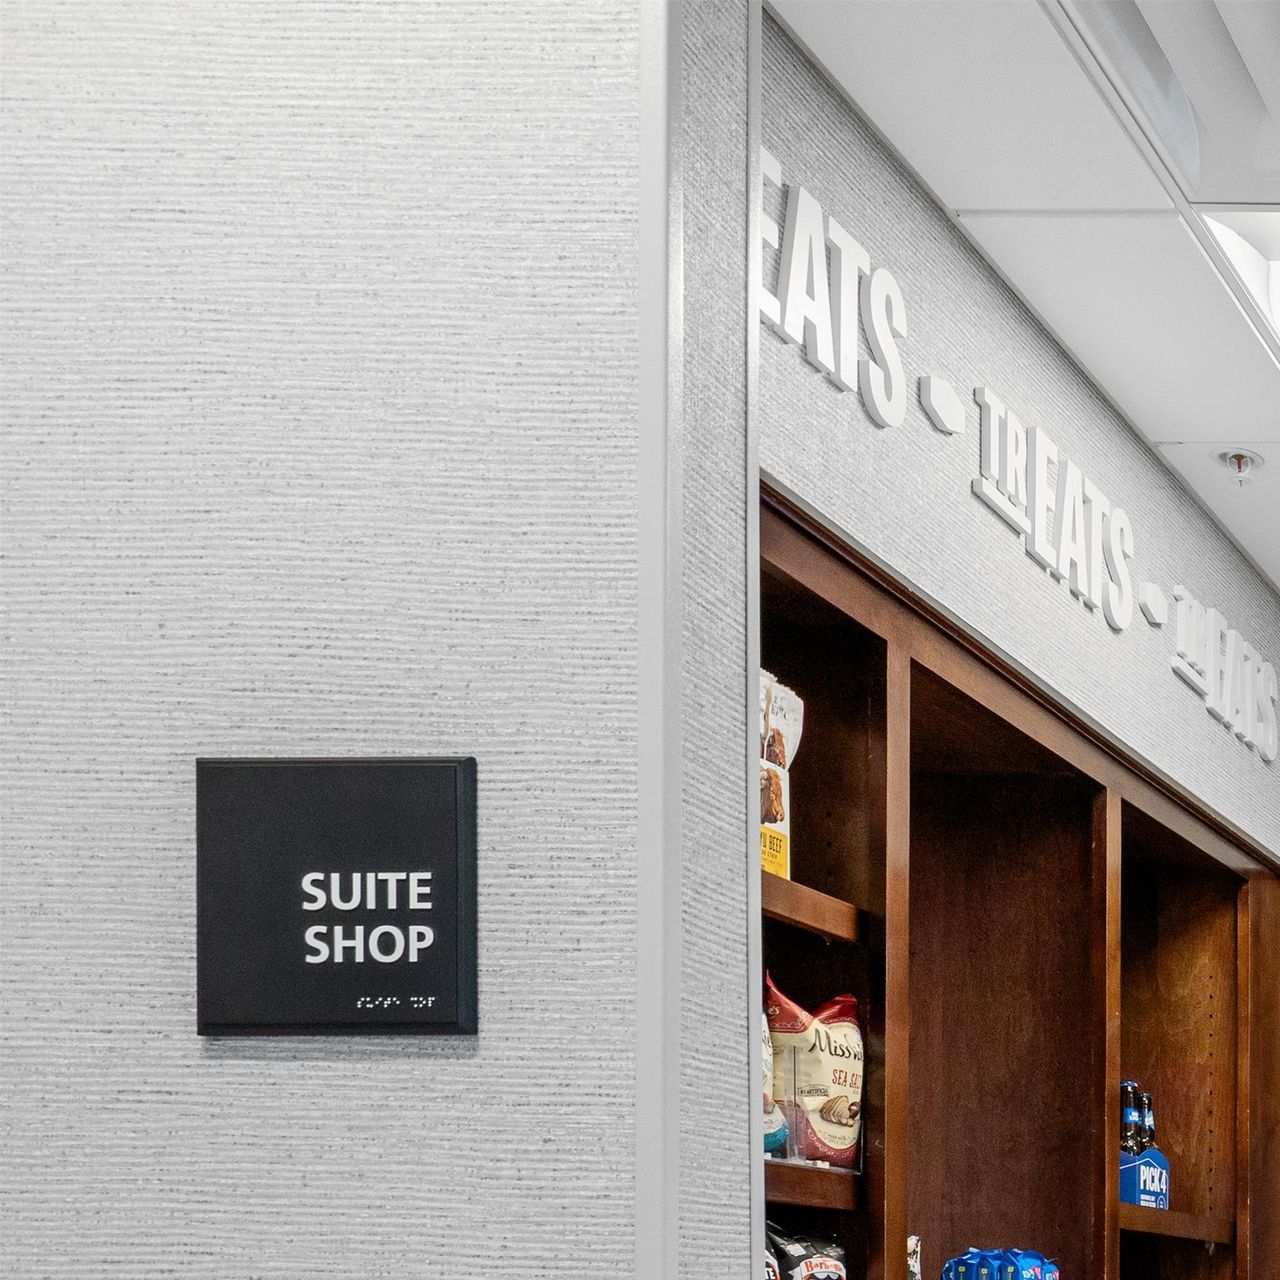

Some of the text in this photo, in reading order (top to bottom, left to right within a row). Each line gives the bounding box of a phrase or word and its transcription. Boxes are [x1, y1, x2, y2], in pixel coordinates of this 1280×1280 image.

[973, 386, 1134, 630] TREATS
[301, 871, 432, 911] SUITE
[304, 925, 434, 963] SHOP
[808, 1028, 852, 1059] Miss
[832, 1068, 849, 1088] SEA
[1140, 1164, 1167, 1194] PICK 4
